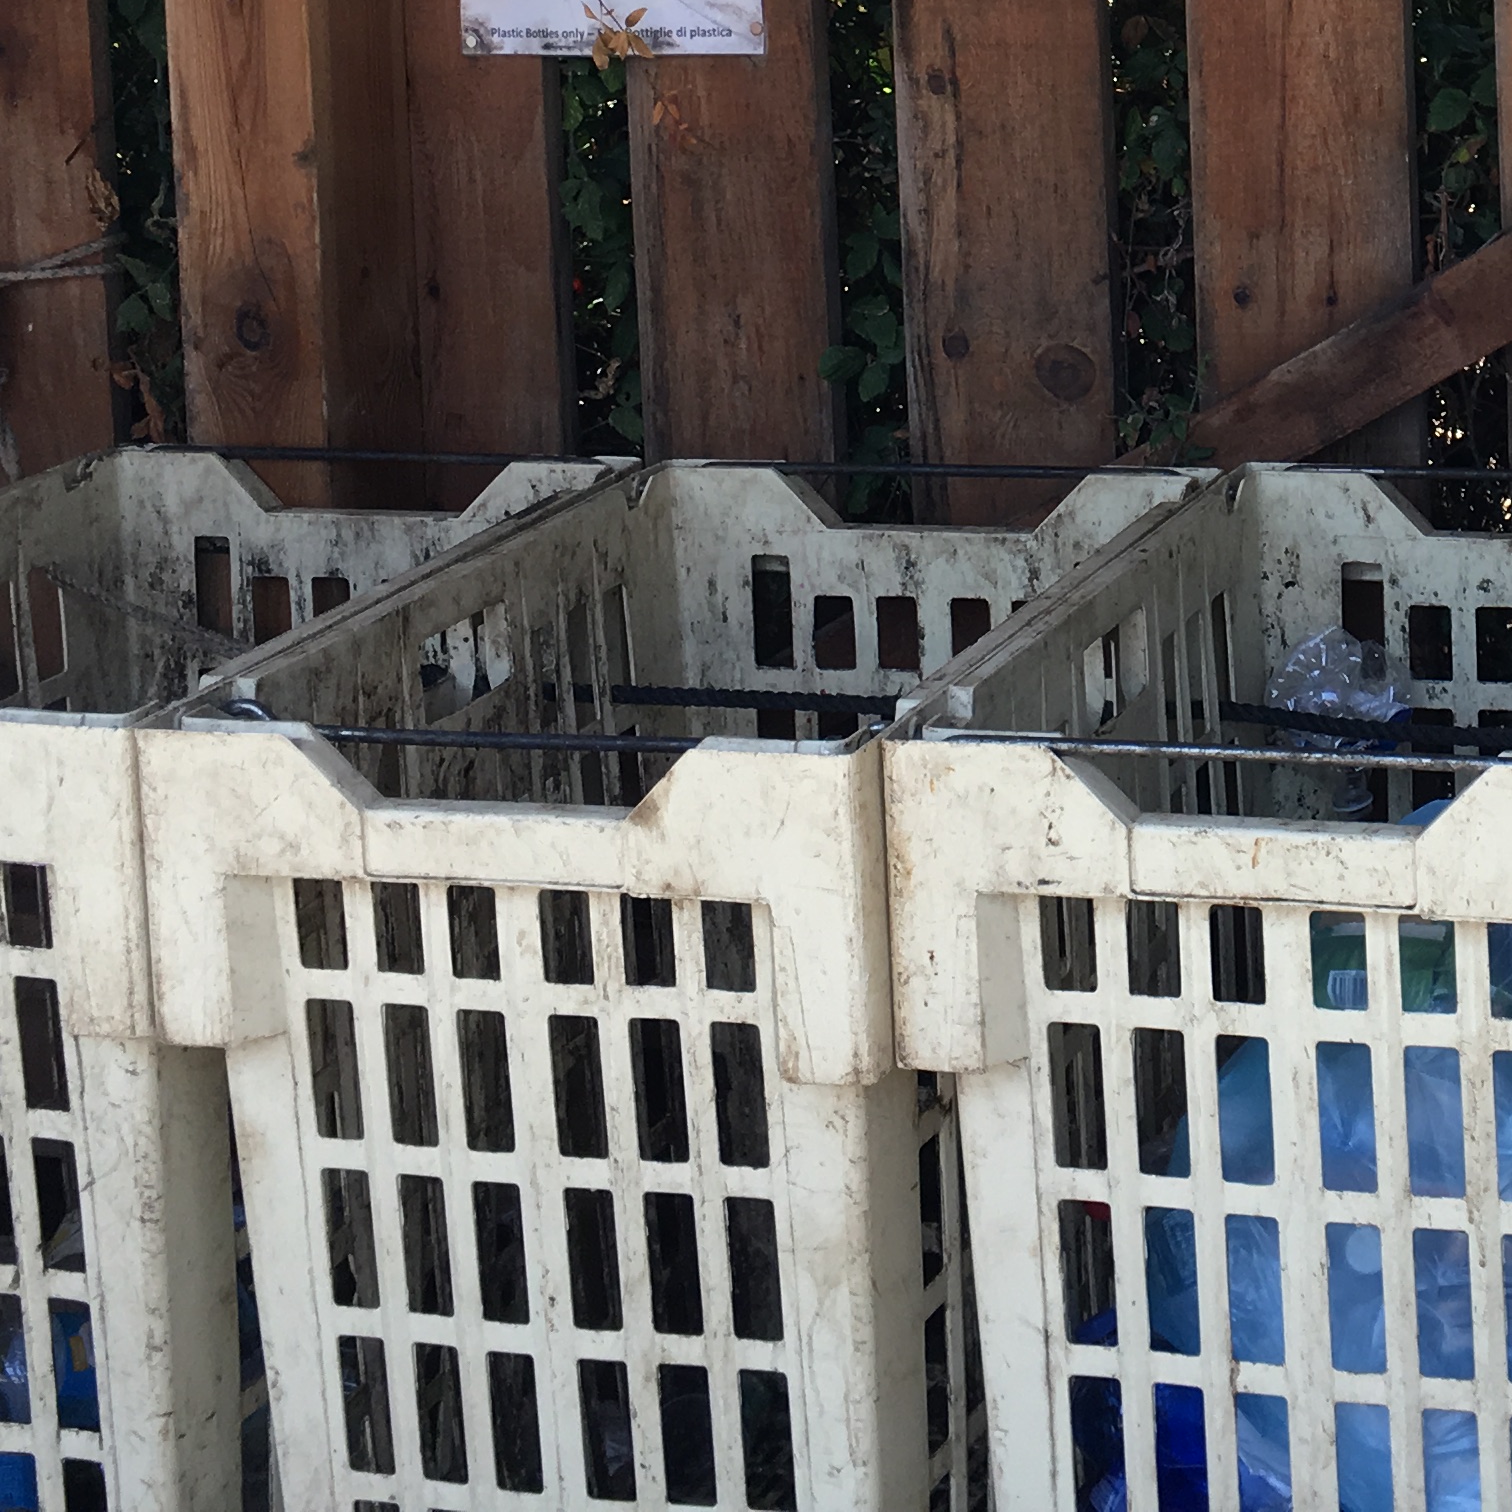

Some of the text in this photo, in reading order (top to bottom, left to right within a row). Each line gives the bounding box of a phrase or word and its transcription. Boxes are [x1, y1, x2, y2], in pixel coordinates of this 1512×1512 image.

[491, 28, 523, 39] Plastic
[525, 28, 559, 39] Bottles
[561, 28, 585, 41] only
[676, 27, 687, 38] di
[689, 27, 733, 39] plastica
